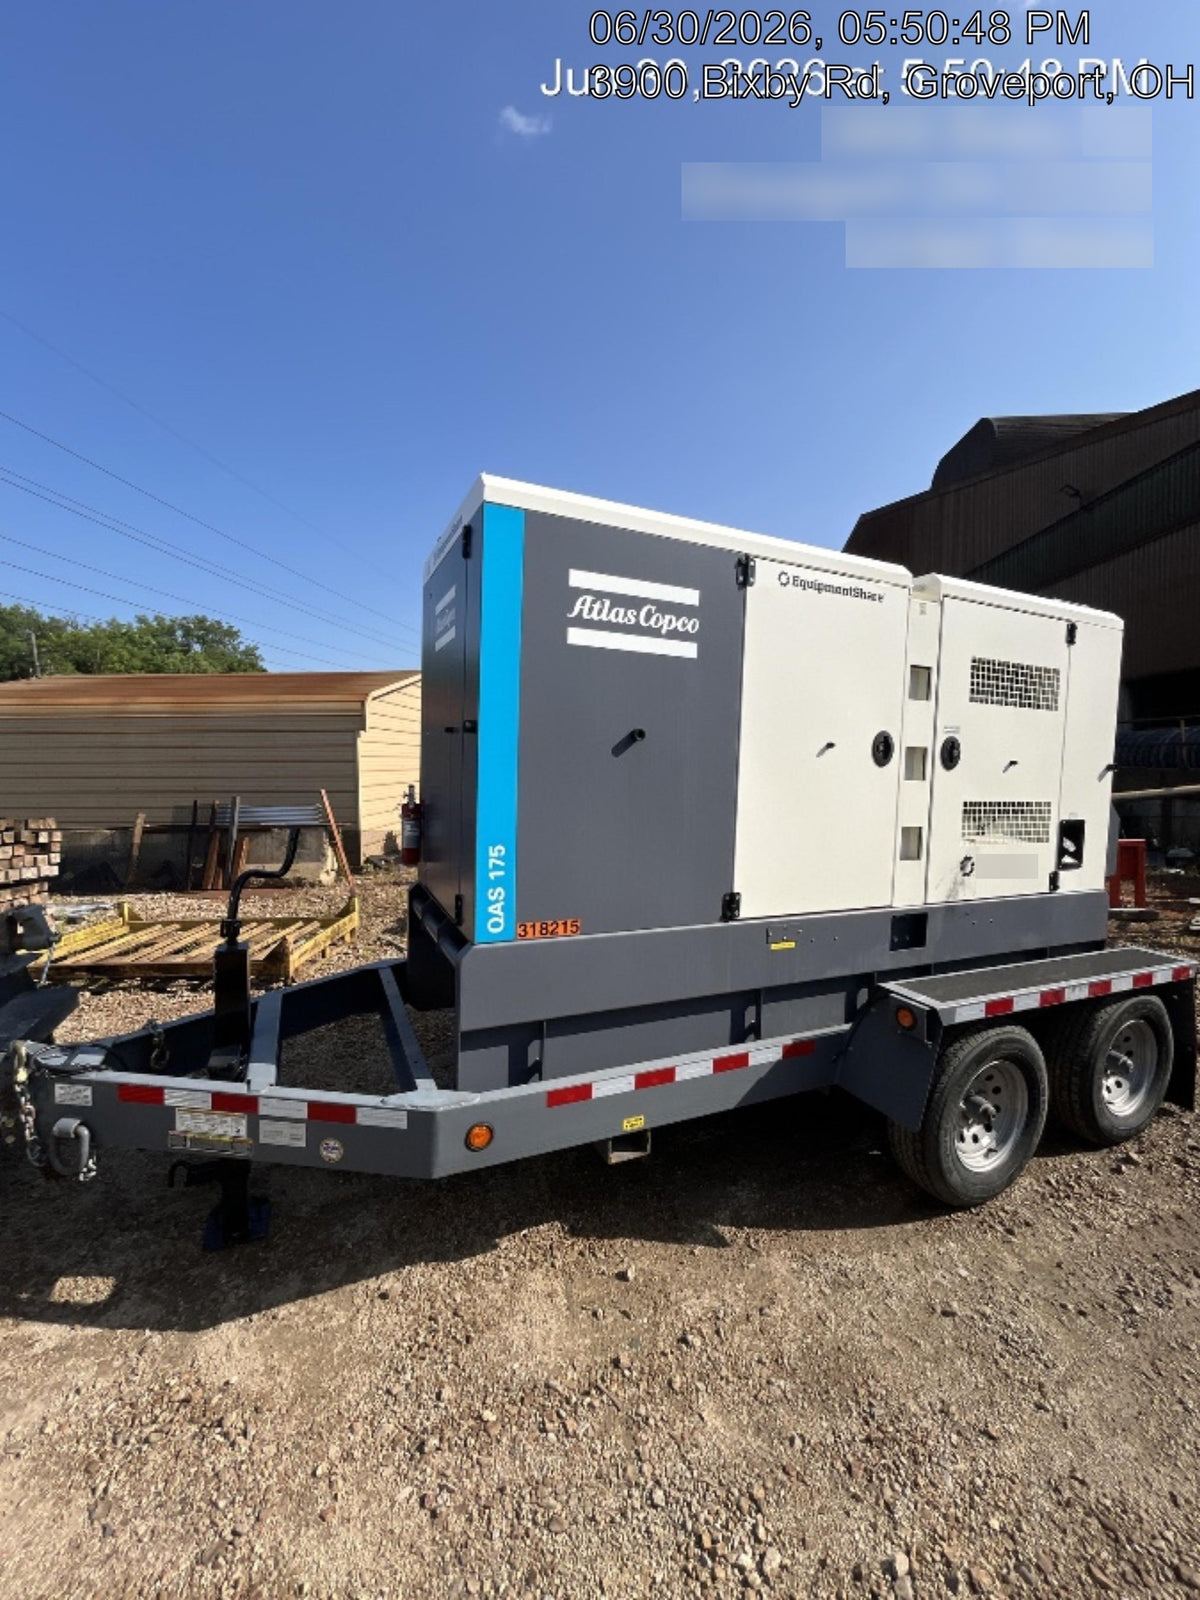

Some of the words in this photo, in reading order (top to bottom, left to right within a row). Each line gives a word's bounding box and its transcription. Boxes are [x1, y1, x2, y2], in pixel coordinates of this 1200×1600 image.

[567, 595, 637, 625] Atlas
[639, 604, 700, 635] Copco
[487, 844, 506, 881] 175
[486, 886, 506, 934] QAS
[517, 920, 580, 938] 318215
